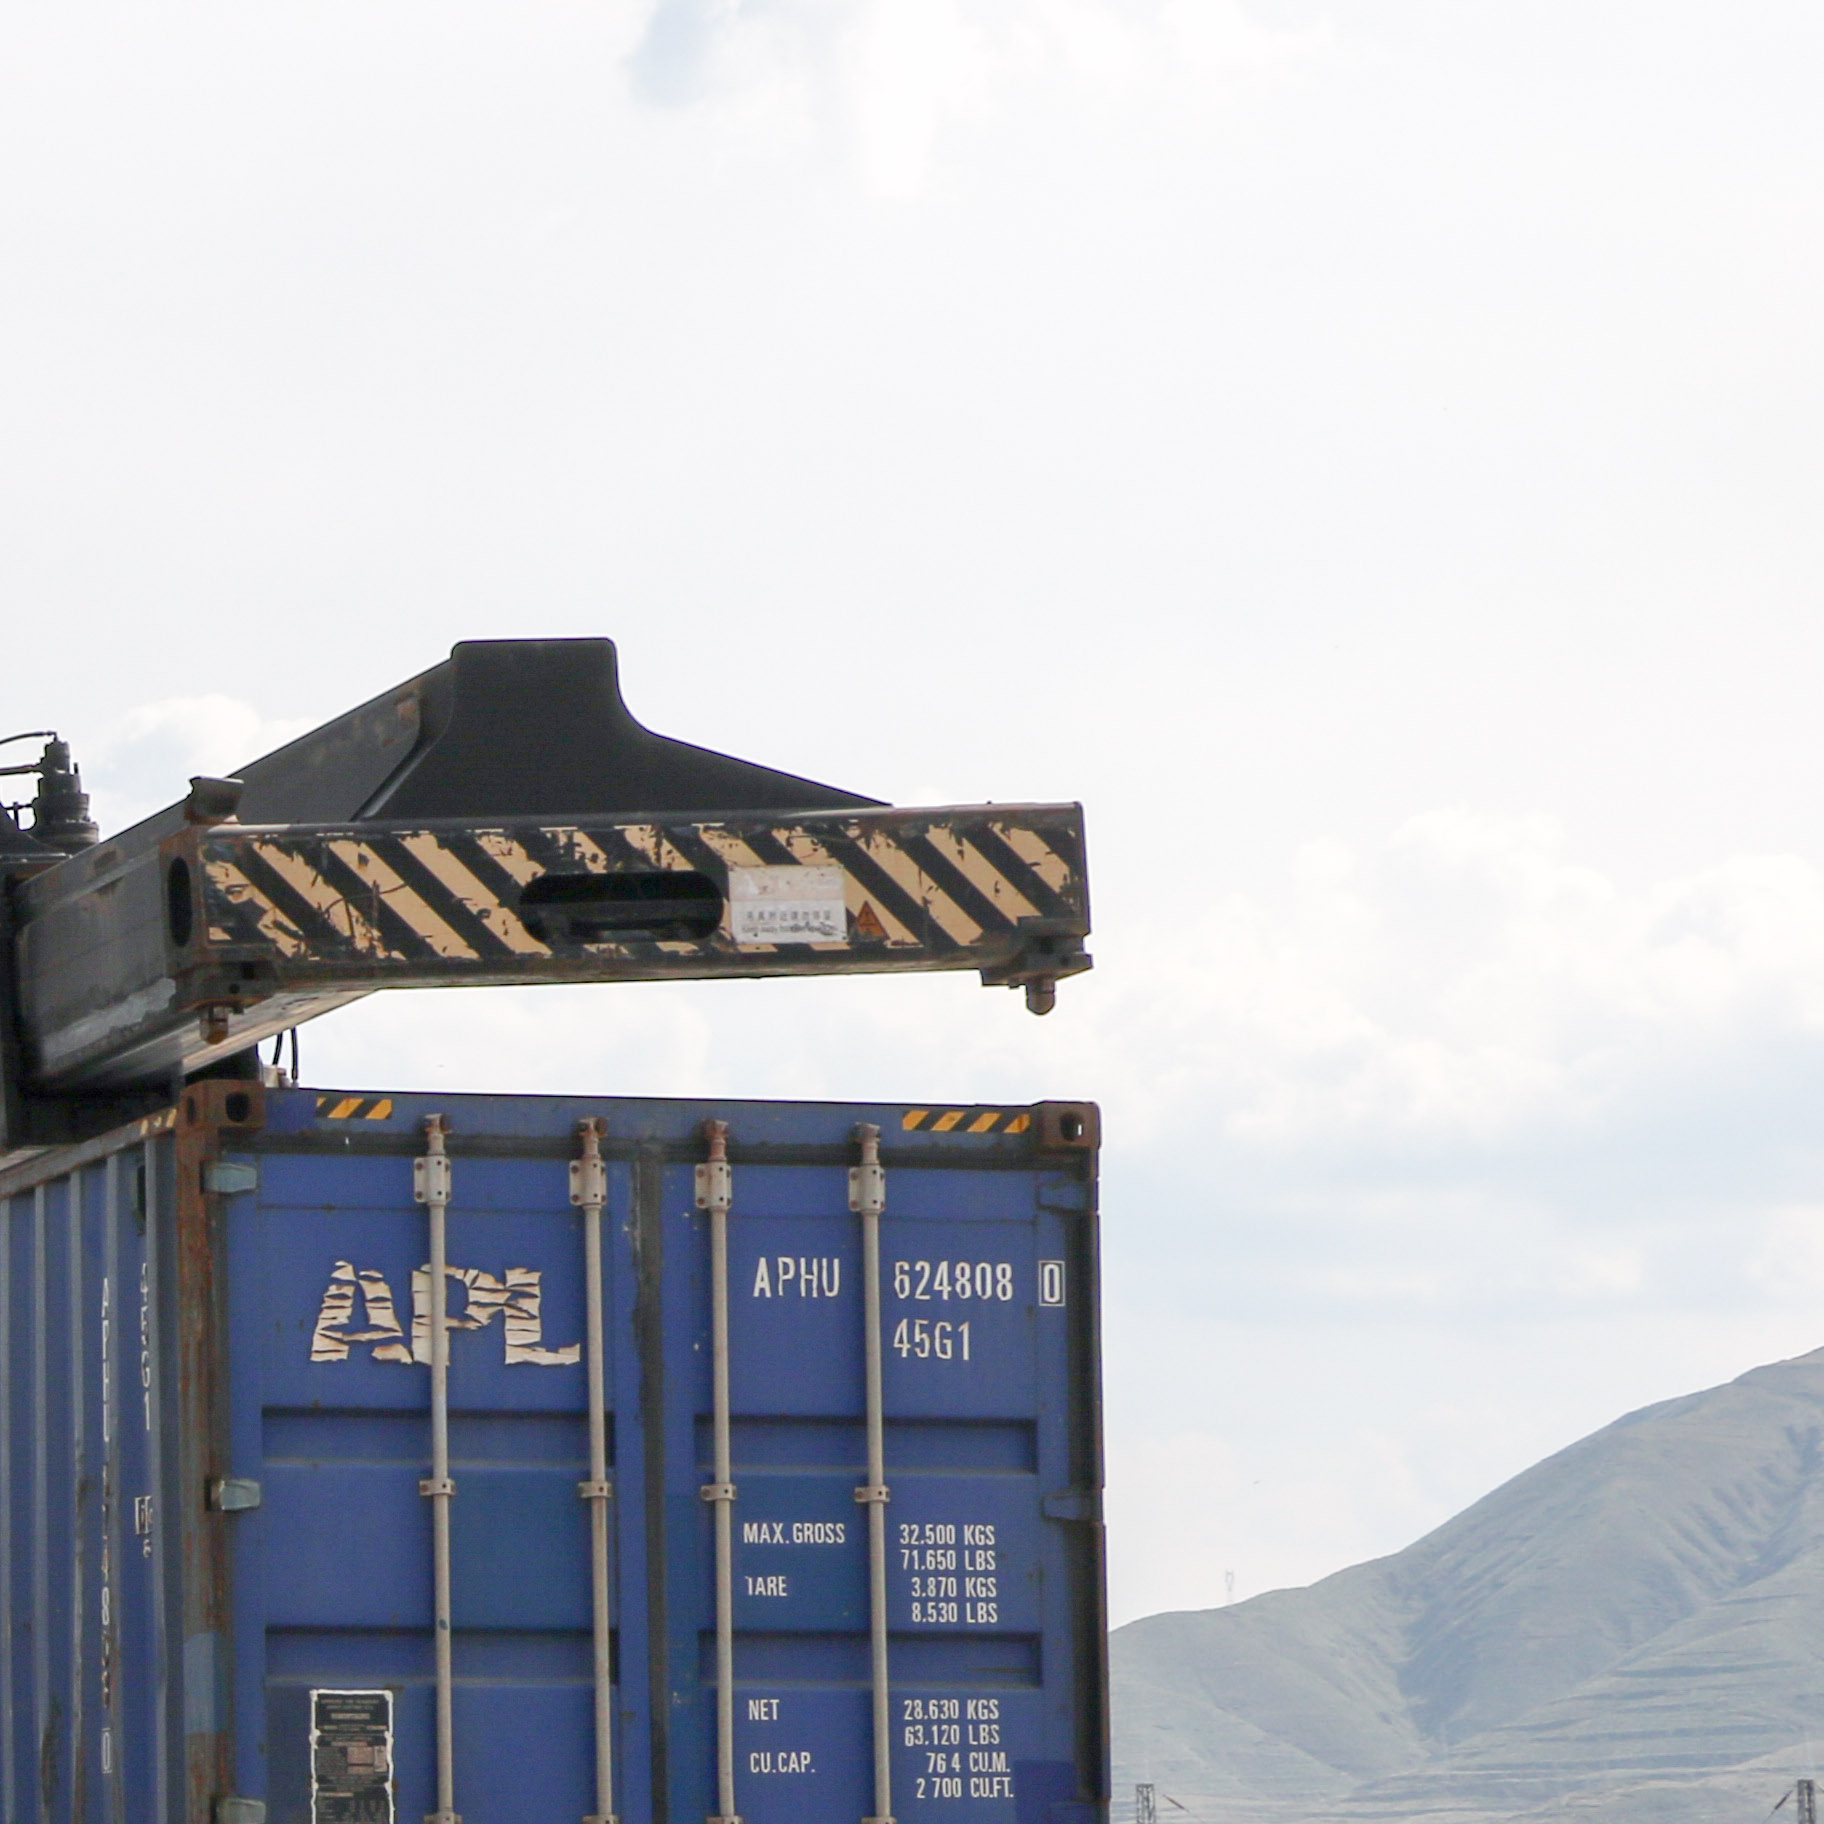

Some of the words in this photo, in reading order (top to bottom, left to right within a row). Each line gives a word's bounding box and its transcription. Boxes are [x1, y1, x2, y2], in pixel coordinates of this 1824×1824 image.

[753, 1257, 840, 1298] APHU
[894, 1260, 1012, 1301] 624808
[1042, 1263, 1061, 1303] 0
[310, 1260, 580, 1366] APL
[893, 1318, 970, 1360] 45G1
[899, 1524, 955, 1545] 32.500
[964, 1524, 995, 1545] KGS
[901, 1549, 956, 1571] 71.650
[965, 1550, 996, 1571] LBS
[911, 1577, 957, 1598] 3.870
[965, 1577, 997, 1598] KGS
[912, 1602, 958, 1623] 8.530
[965, 1602, 998, 1623] LBS
[748, 1699, 780, 1720] NET
[904, 1700, 959, 1720] 28.630
[966, 1699, 999, 1720] KGS
[905, 1725, 960, 1746] 63.120
[968, 1725, 1000, 1745] LBS
